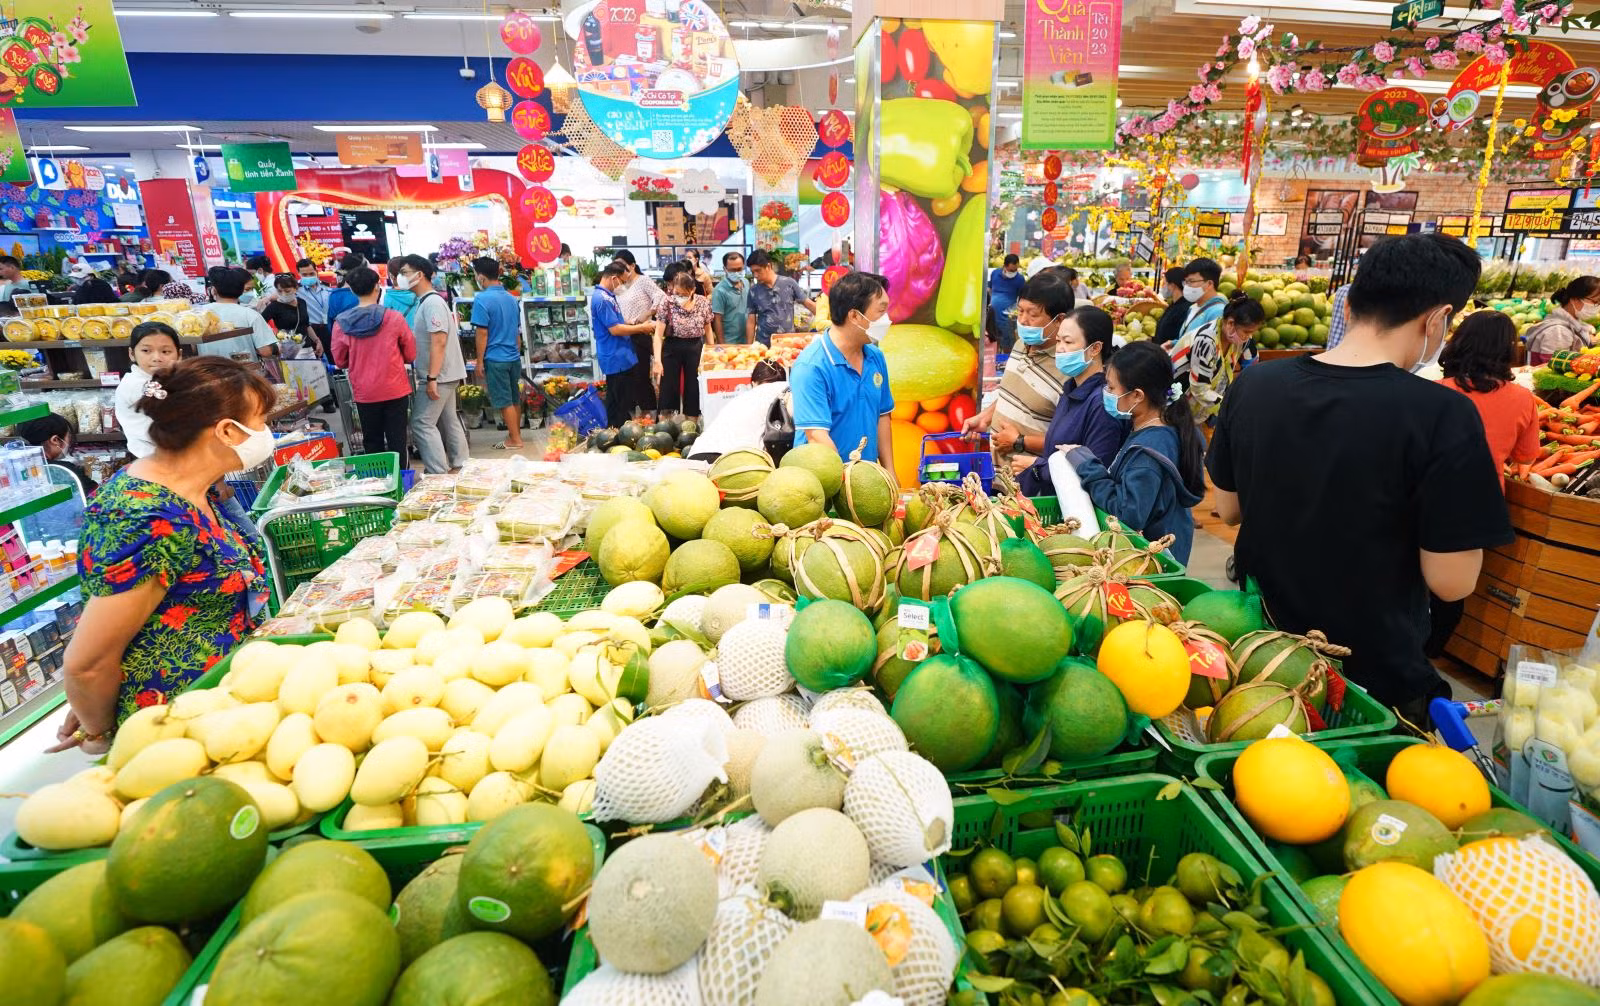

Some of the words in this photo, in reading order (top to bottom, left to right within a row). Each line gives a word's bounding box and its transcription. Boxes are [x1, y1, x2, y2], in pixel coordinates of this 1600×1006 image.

[610, 7, 636, 22] 2023
[1038, 19, 1084, 41] Thành
[1092, 28, 1107, 39] 20
[1049, 44, 1082, 64] Viên
[1091, 43, 1106, 54] 23
[258, 158, 276, 168] Quầy
[44, 164, 55, 179] 4
[245, 170, 259, 178] tính
[260, 168, 275, 178] tiền
[904, 612, 924, 620] Select
[1189, 648, 1221, 669] Tài
